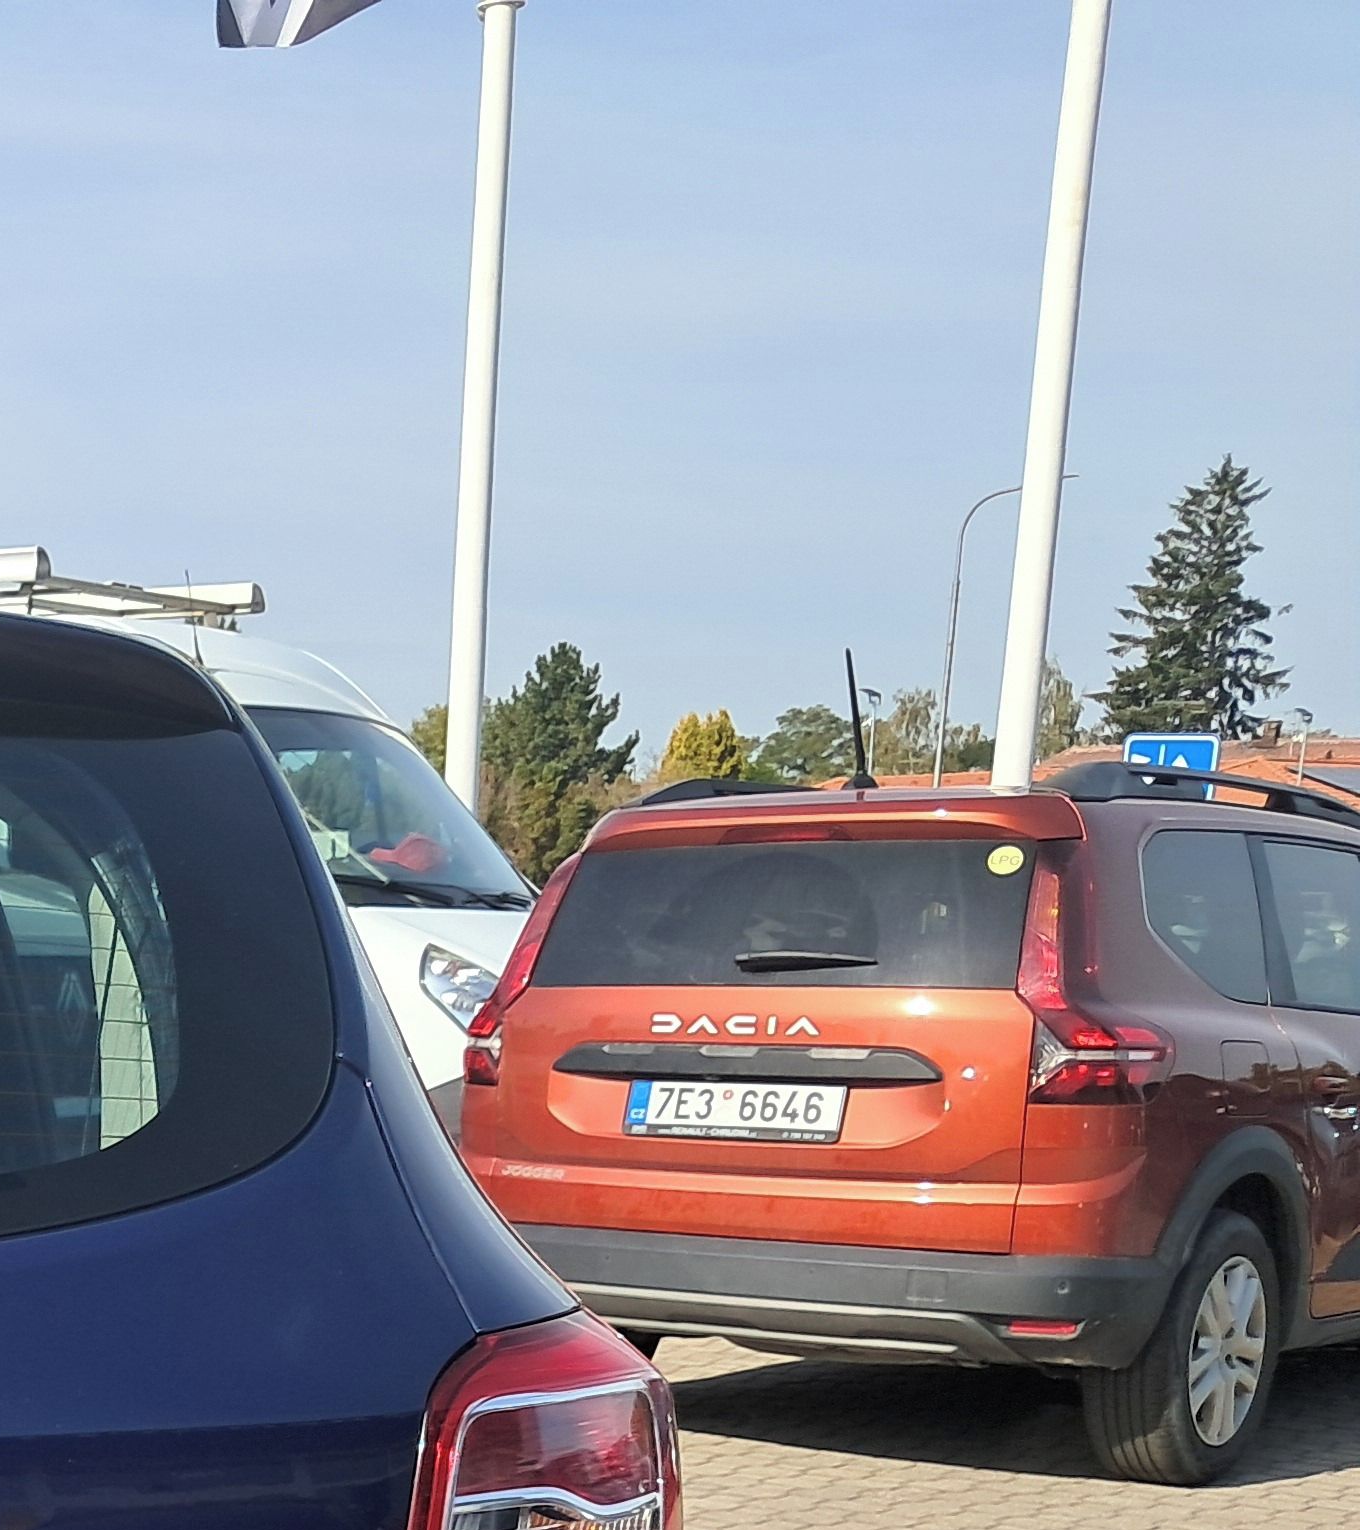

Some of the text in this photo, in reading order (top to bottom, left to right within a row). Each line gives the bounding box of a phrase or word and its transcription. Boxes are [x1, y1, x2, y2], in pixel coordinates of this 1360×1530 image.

[990, 855, 1020, 866] LPG
[650, 1013, 820, 1036] DACIA
[654, 1087, 715, 1120] 7E3
[738, 1089, 825, 1124] 6646
